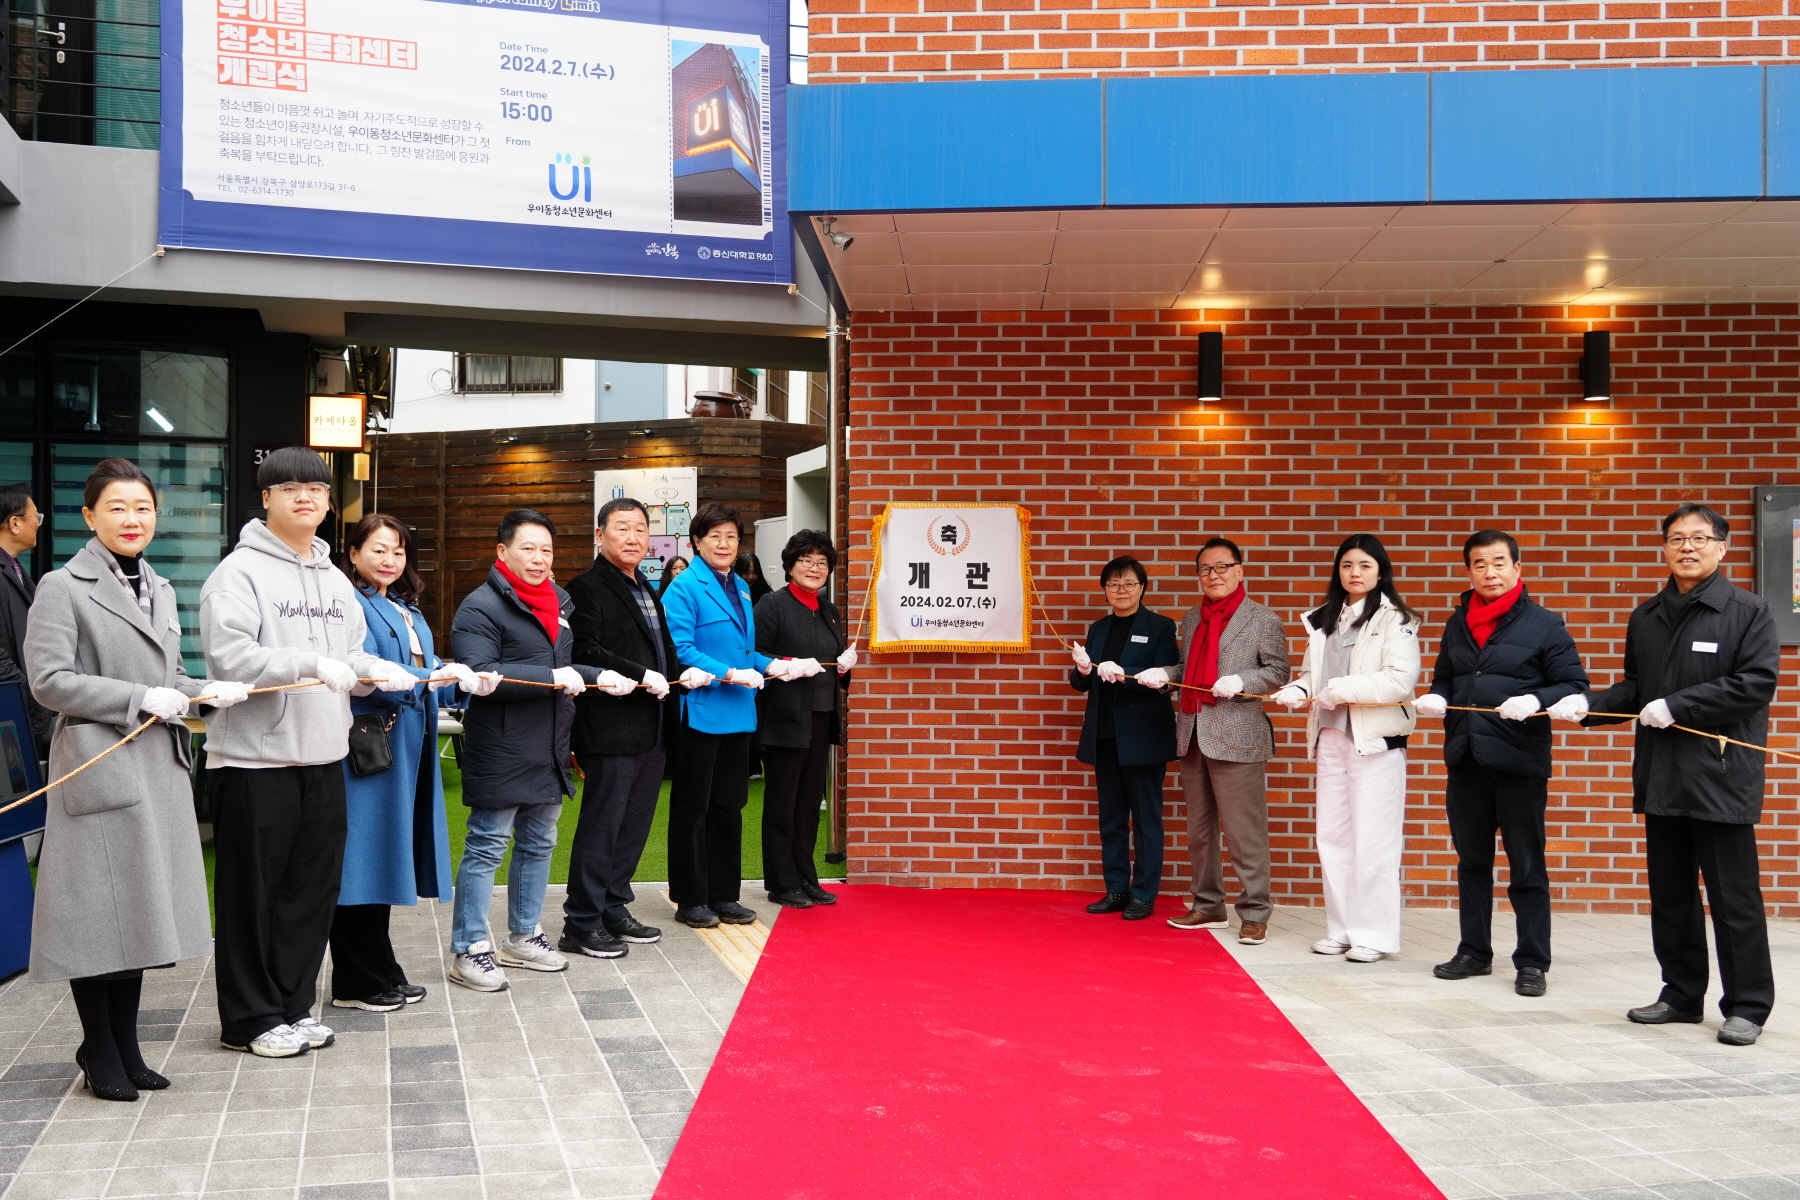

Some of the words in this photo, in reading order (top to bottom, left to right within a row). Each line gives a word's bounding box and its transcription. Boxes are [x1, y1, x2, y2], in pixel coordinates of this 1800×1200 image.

[217, 21, 417, 70] 청소년문화센터
[500, 41, 523, 51] Date
[525, 44, 549, 54] Time
[217, 55, 307, 92] 개관식
[500, 54, 615, 81] 2024.2.7.(수)
[500, 87, 523, 97] Start
[526, 90, 548, 99] time
[219, 98, 275, 114] 청소년들이
[277, 103, 310, 118] 마음껏
[312, 107, 335, 119] 쉬고
[337, 109, 359, 121] 놀며
[363, 111, 438, 128] 자기주도적으로
[440, 118, 472, 132] 성장할
[474, 121, 485, 132] 수
[500, 101, 553, 122] 15:00
[219, 114, 241, 128] 있는
[244, 116, 345, 138] 청소년이용권장시설,
[347, 125, 465, 146] 우이동청소년문화센터가
[466, 136, 478, 147] 그
[479, 136, 490, 149] 첫
[506, 136, 531, 147] From
[219, 131, 252, 145] 걸음을
[254, 134, 288, 147] 힘차게
[336, 141, 372, 155] 합니다.
[377, 145, 387, 155] 그
[390, 145, 412, 158] 힘찬
[413, 147, 456, 162] 발걸음에
[458, 151, 490, 164] 응원과
[219, 147, 252, 162] 축복을
[255, 150, 324, 167] 부탁드립니다.
[216, 173, 258, 185] 서울특별시
[261, 176, 286, 187] 강북구
[337, 183, 356, 192] 31-6
[217, 184, 236, 193] TEL.
[238, 185, 294, 197] 02-6314-1730
[527, 203, 612, 219] 우이동청소년문화센터
[756, 252, 773, 261] R&D
[940, 524, 957, 545] 축
[907, 562, 930, 589] 개
[966, 562, 991, 590] 관
[900, 596, 997, 609] 2024.02.07.(수)
[925, 618, 984, 629] 우이동청소년문화센터
